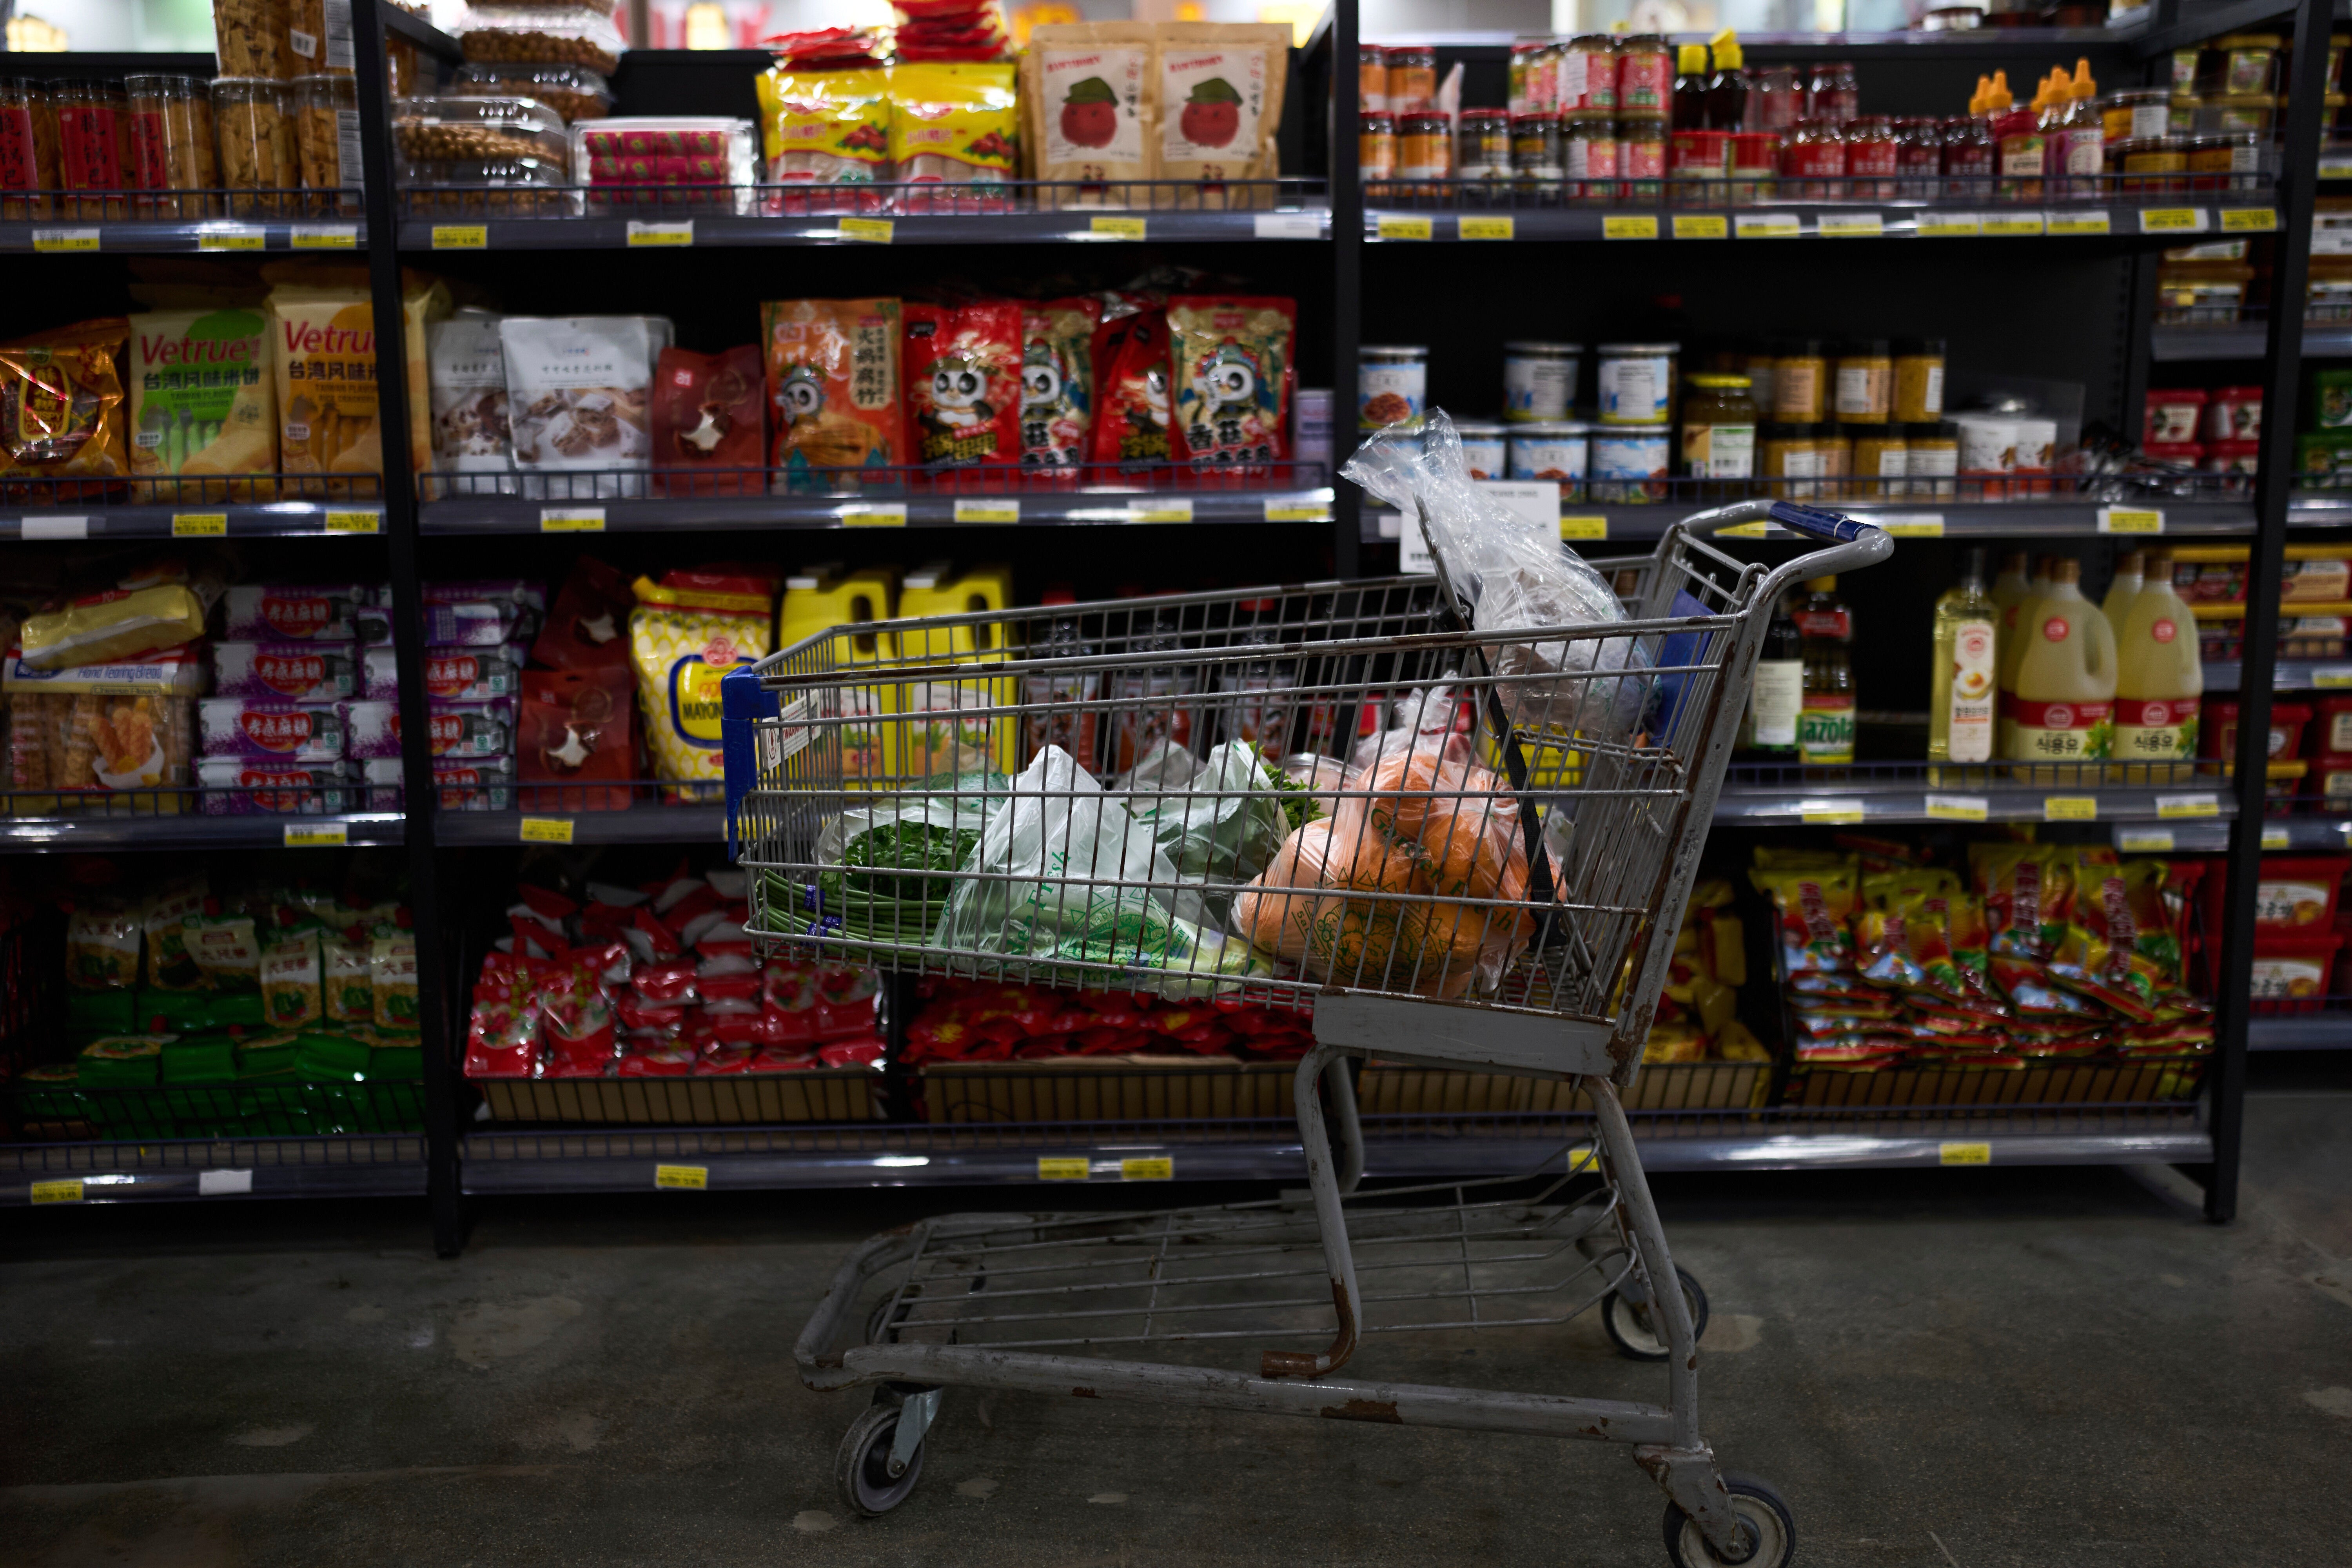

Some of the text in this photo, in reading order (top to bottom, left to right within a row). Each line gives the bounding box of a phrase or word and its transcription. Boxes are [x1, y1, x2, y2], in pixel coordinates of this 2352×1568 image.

[285, 321, 376, 355] Vetru
[140, 334, 249, 366] Vetrue
[143, 367, 260, 390] 台湾风味米饼
[102, 591, 115, 602] 10
[78, 664, 162, 682] Hand Tearing Bread
[259, 659, 323, 682] 孝感麻糖
[94, 687, 128, 696] Cheese
[246, 716, 310, 738] 孝感麻糖
[2036, 738, 2078, 755] 식용유
[2135, 735, 2173, 753] 식용유
[1450, 879, 1512, 931] Fesh
